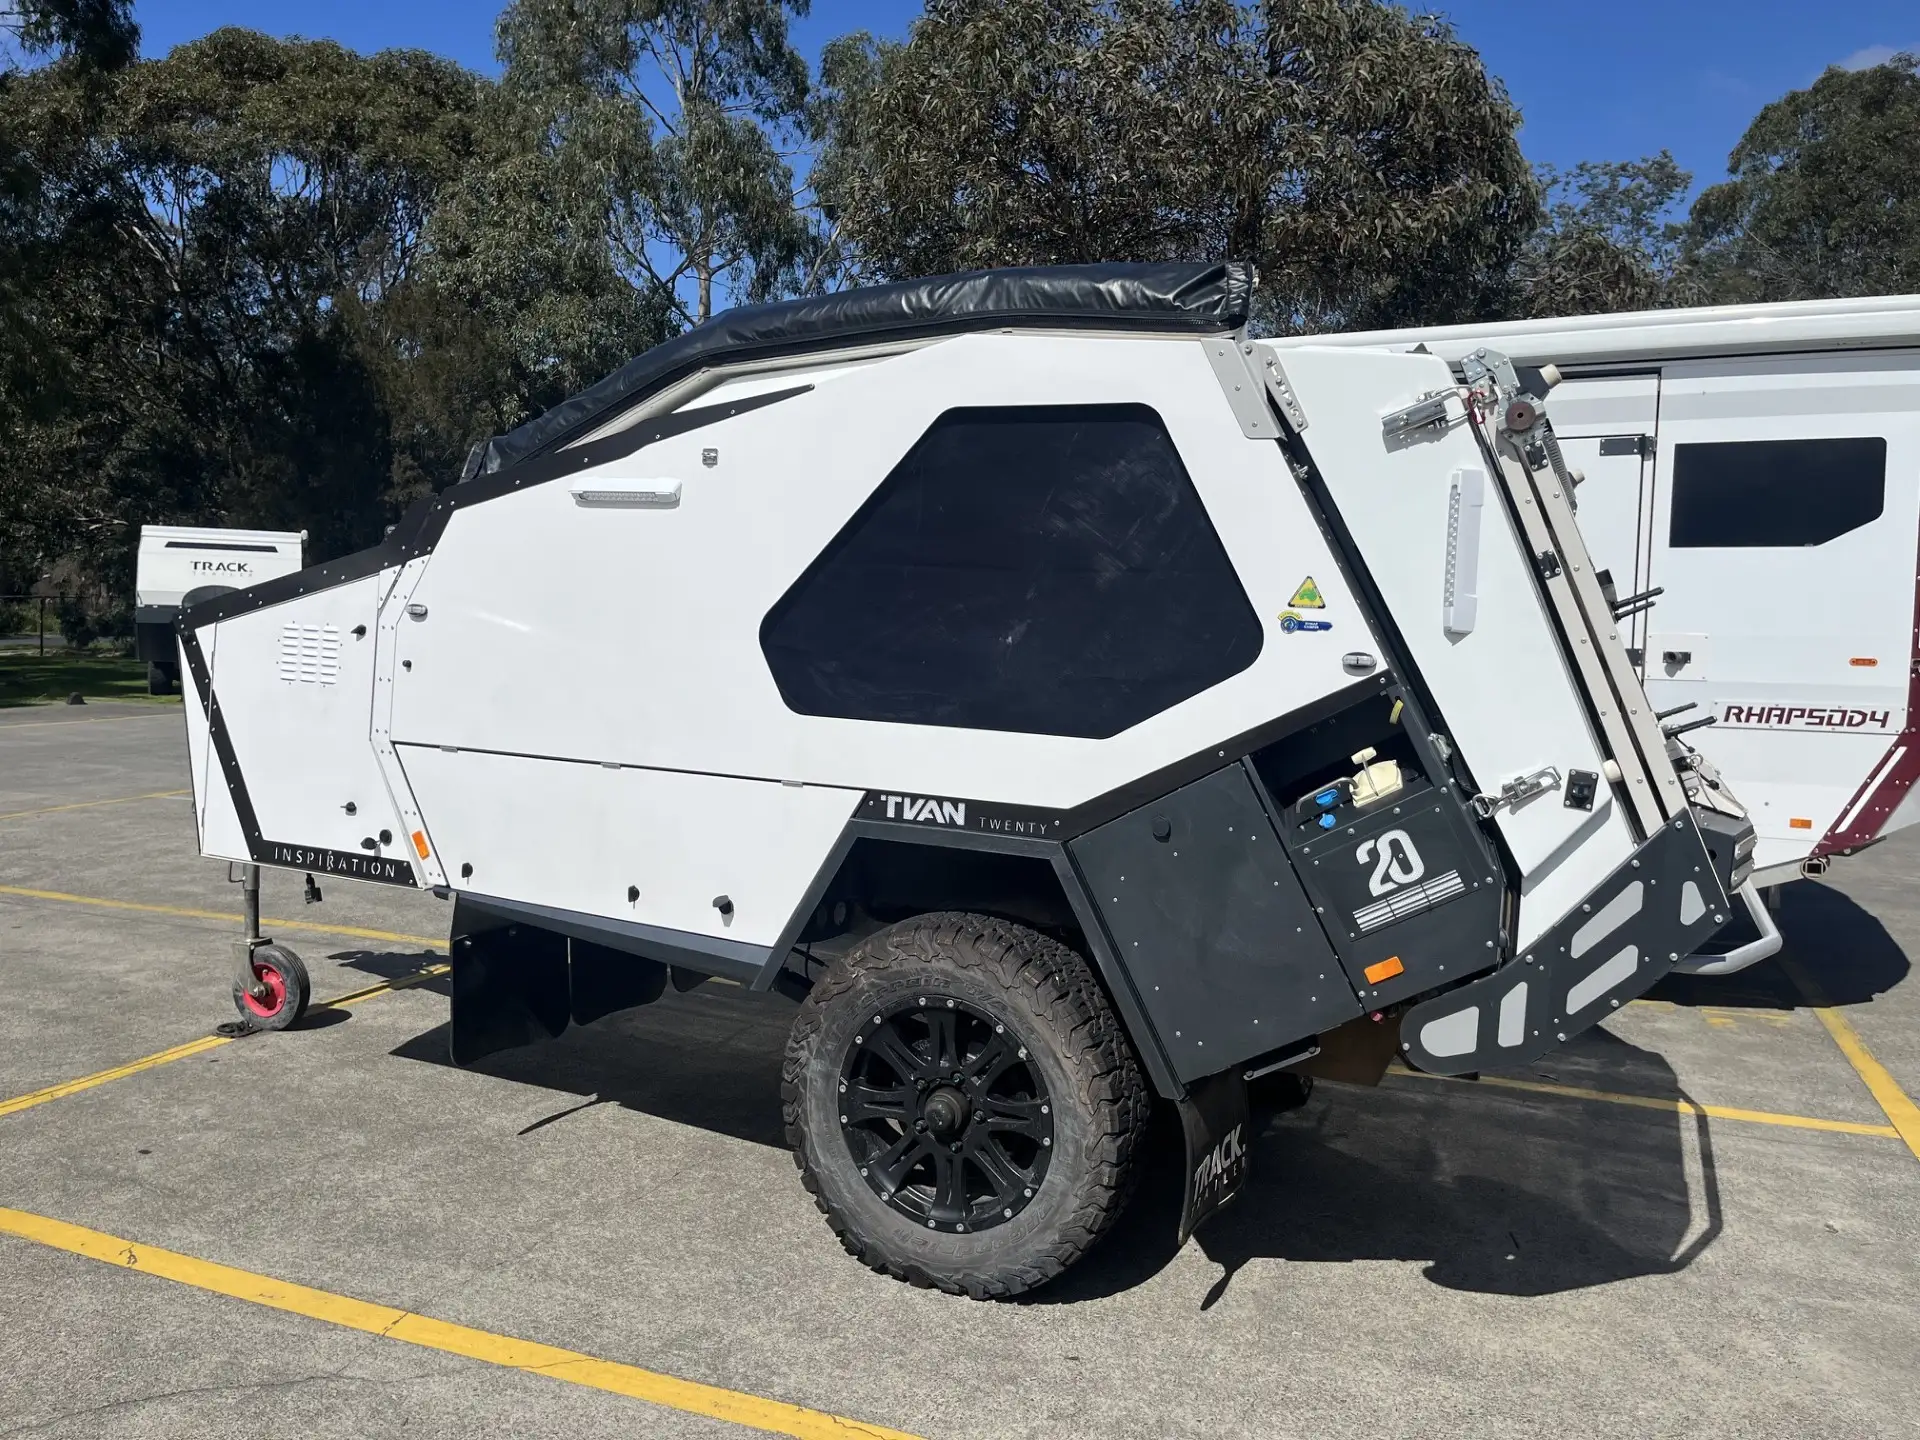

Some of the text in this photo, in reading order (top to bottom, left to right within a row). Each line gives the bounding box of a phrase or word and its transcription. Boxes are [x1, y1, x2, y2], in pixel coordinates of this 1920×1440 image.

[1723, 705, 1890, 729] RHAPSODY
[880, 794, 1048, 835] TVAN TWENTY
[274, 846, 396, 878] INSPIRATION
[1355, 829, 1425, 897] 20
